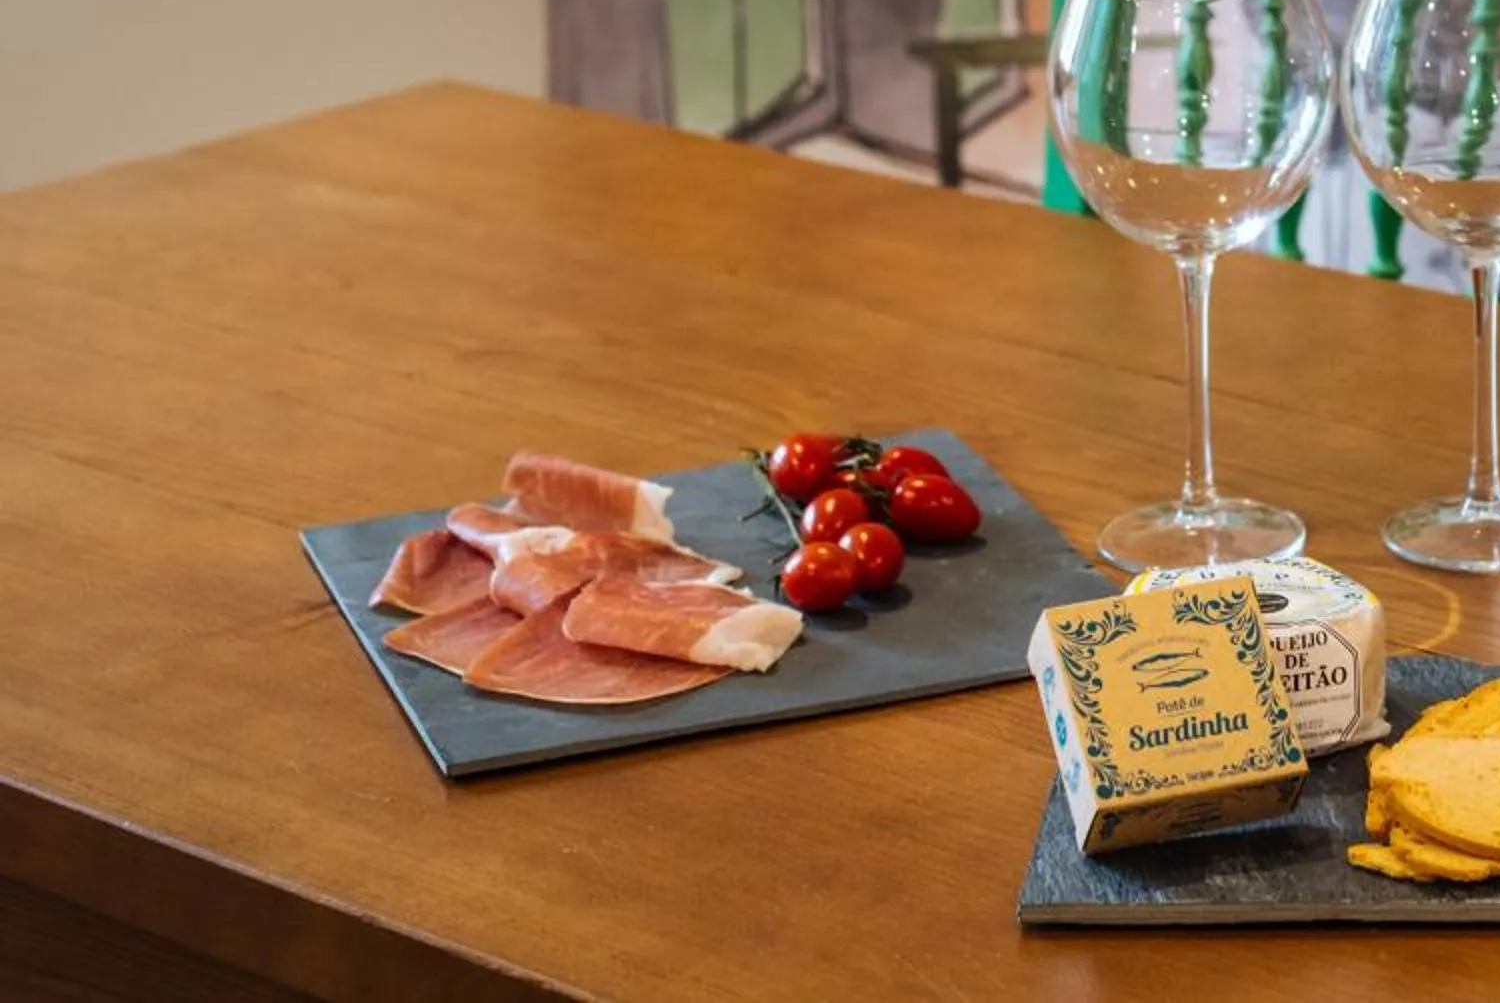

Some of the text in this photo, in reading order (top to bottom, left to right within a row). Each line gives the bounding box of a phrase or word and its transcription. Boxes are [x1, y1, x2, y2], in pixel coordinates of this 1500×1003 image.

[1270, 631, 1328, 652] UEIJO
[1285, 652, 1309, 669] DE
[1281, 665, 1348, 694] EITÃO
[1189, 696, 1205, 708] de
[1129, 711, 1249, 751] Sardinha
